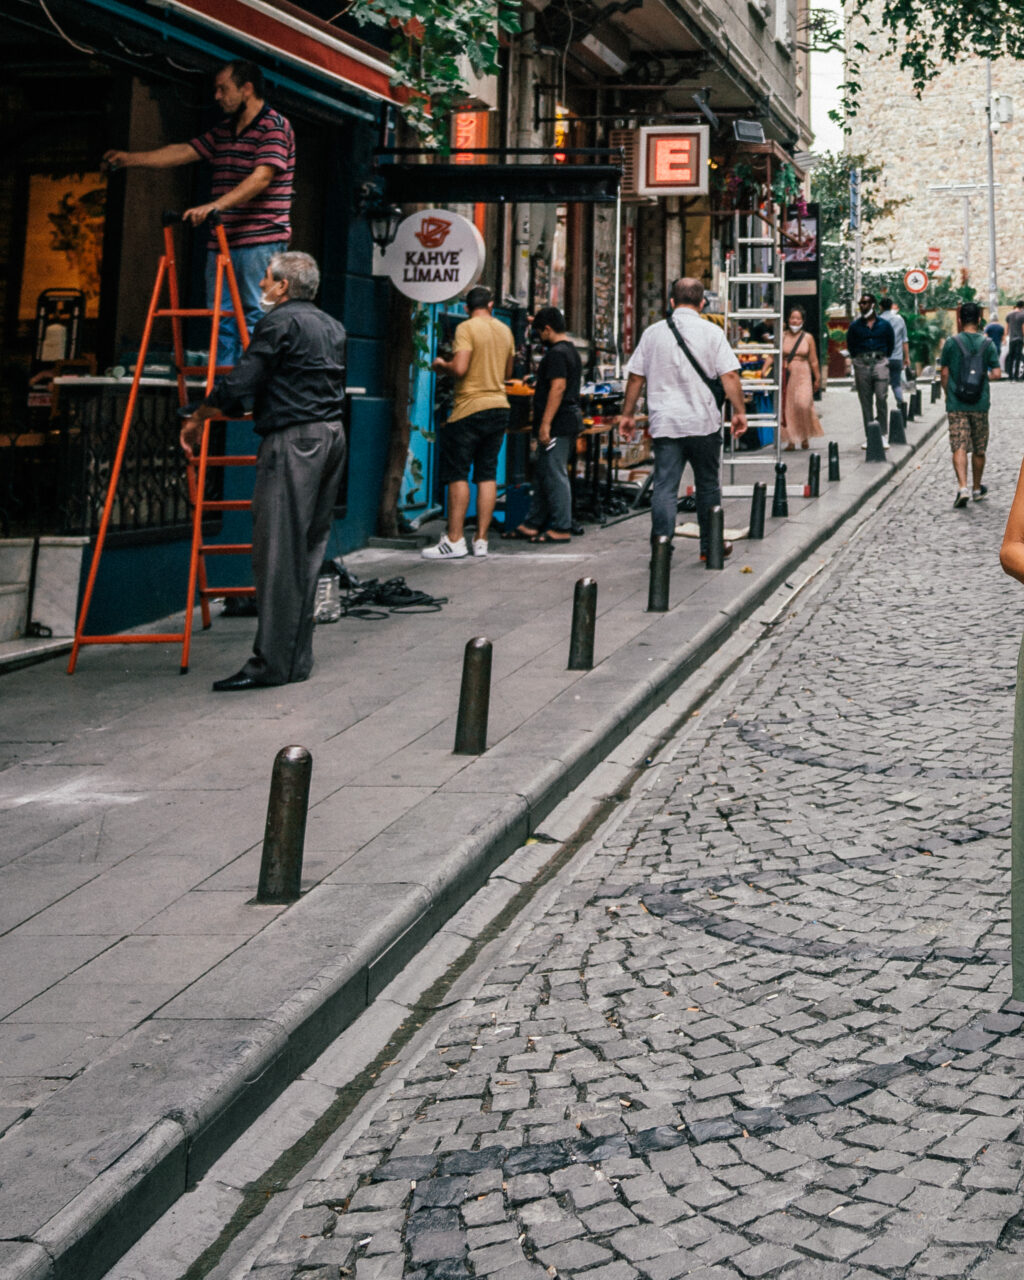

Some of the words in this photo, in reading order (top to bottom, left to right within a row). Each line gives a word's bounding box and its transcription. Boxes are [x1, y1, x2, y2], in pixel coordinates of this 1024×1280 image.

[655, 139, 692, 182] E
[405, 251, 460, 266] KAHVE
[403, 266, 460, 282] LİMANI
